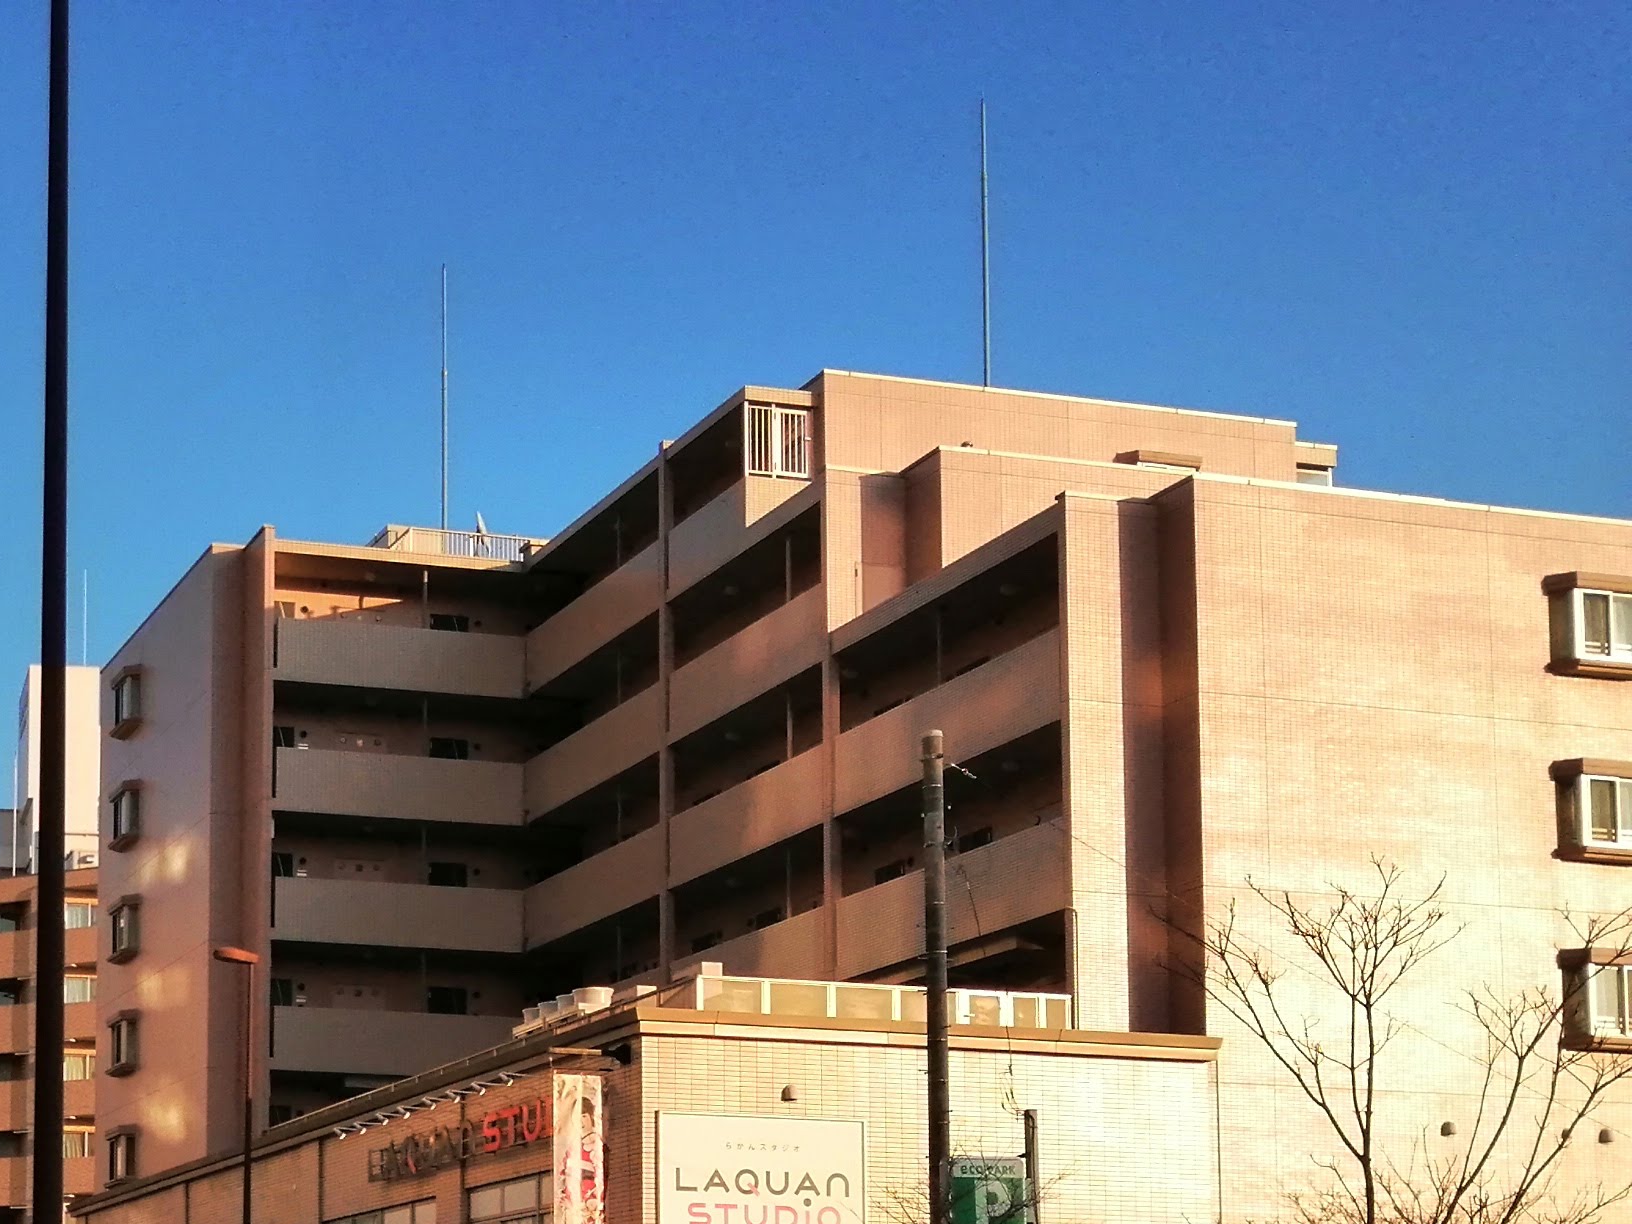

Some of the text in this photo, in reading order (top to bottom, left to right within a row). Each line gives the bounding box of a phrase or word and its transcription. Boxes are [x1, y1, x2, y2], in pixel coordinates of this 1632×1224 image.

[725, 1142, 801, 1153] らかんスタジオ
[675, 1167, 850, 1198] LAQUAN
